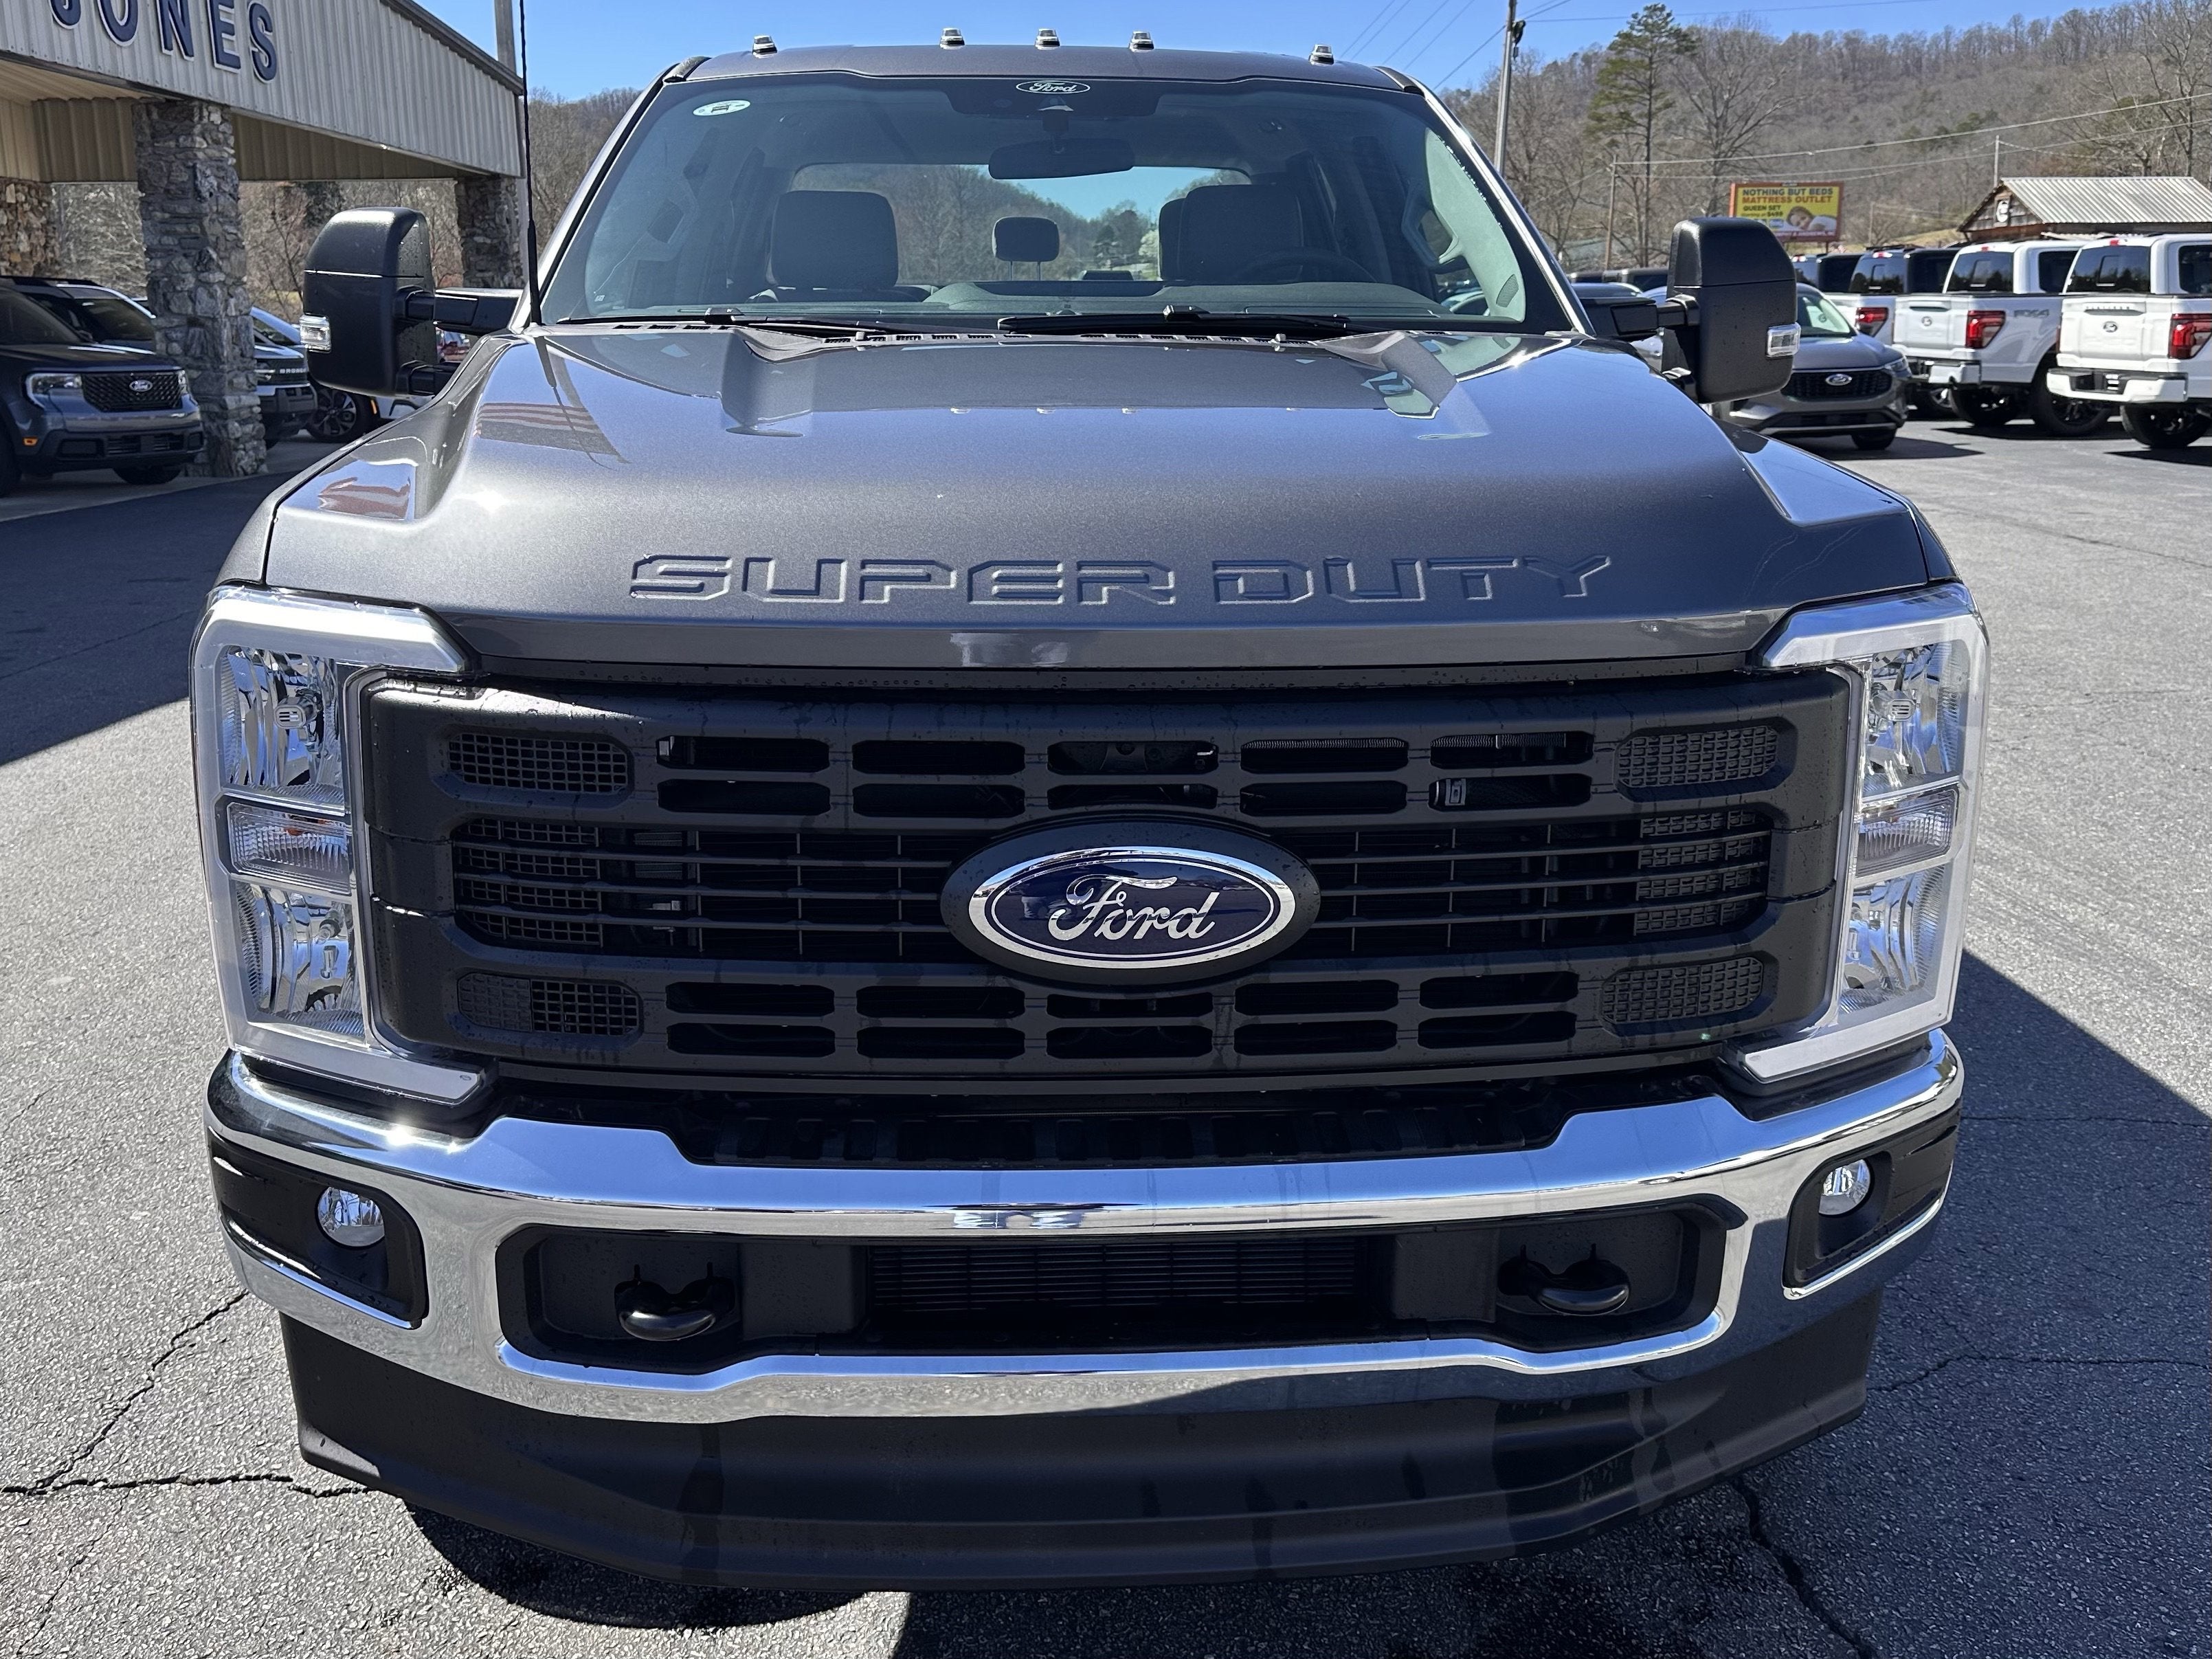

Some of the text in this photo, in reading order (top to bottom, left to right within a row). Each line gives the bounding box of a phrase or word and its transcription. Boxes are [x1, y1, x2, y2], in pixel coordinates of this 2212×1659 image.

[1029, 82, 1077, 92] Ford
[1788, 188, 1807, 196] BUT
[1809, 188, 1833, 196] BEDS
[630, 555, 1612, 605] SUPER DUTY
[1048, 874, 1220, 940] Ford
